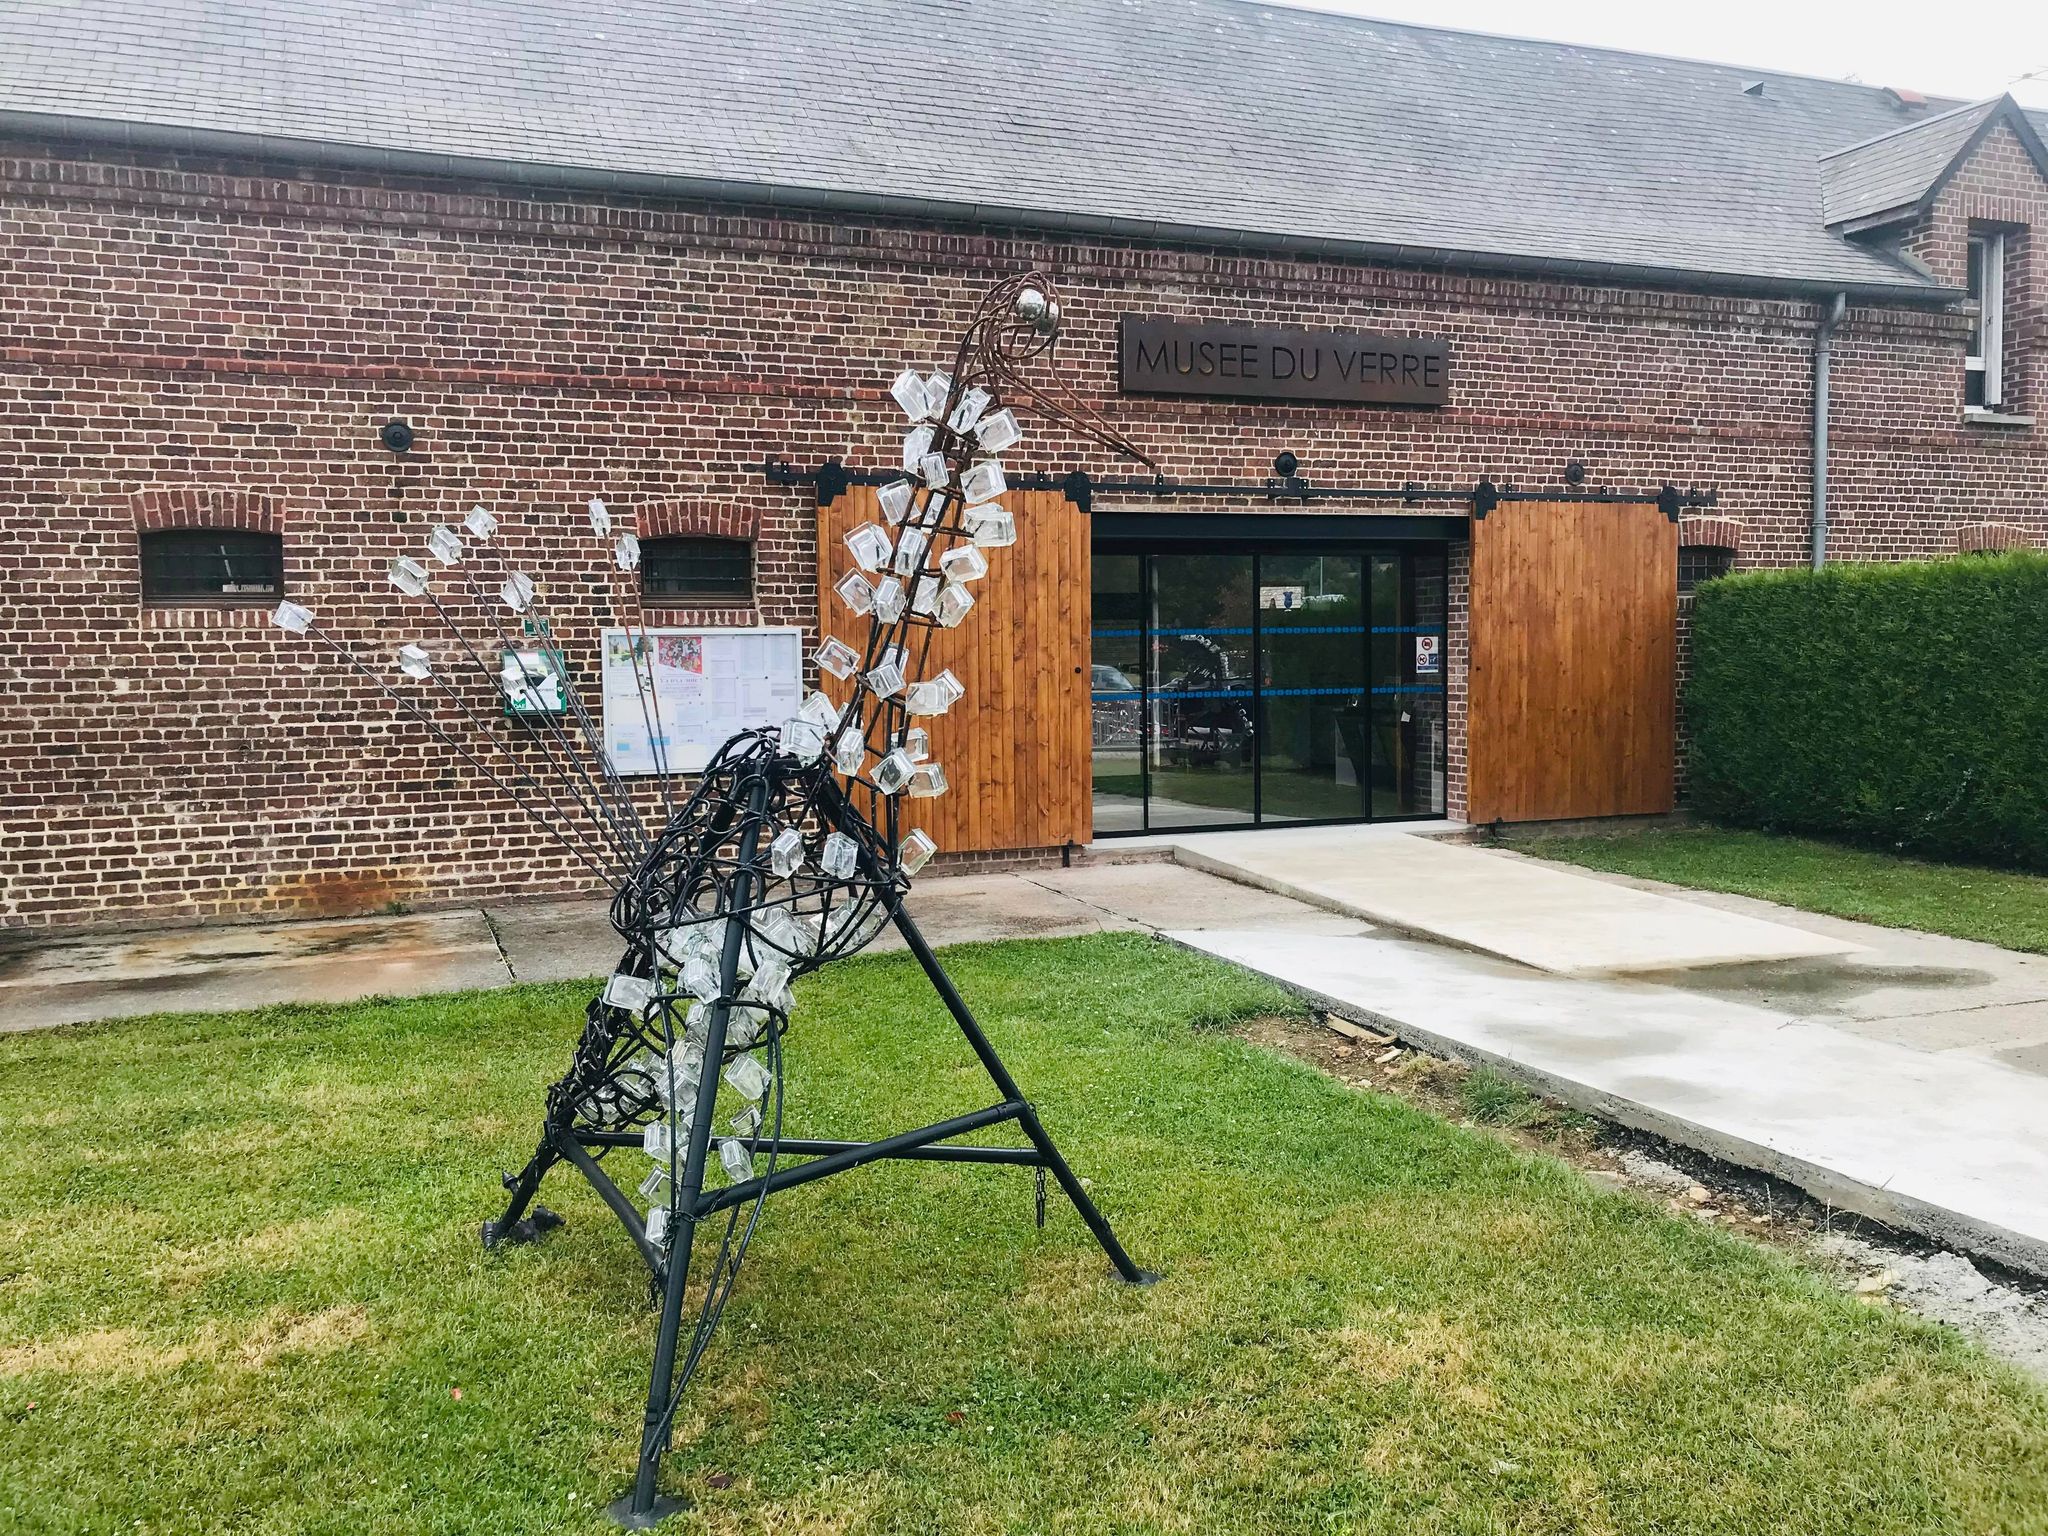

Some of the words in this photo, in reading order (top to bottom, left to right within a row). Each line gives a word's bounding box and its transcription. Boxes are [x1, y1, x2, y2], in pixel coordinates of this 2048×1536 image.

[1135, 338, 1259, 379] MUSEE
[1272, 346, 1320, 381] DU
[1333, 350, 1440, 388] VERRE
